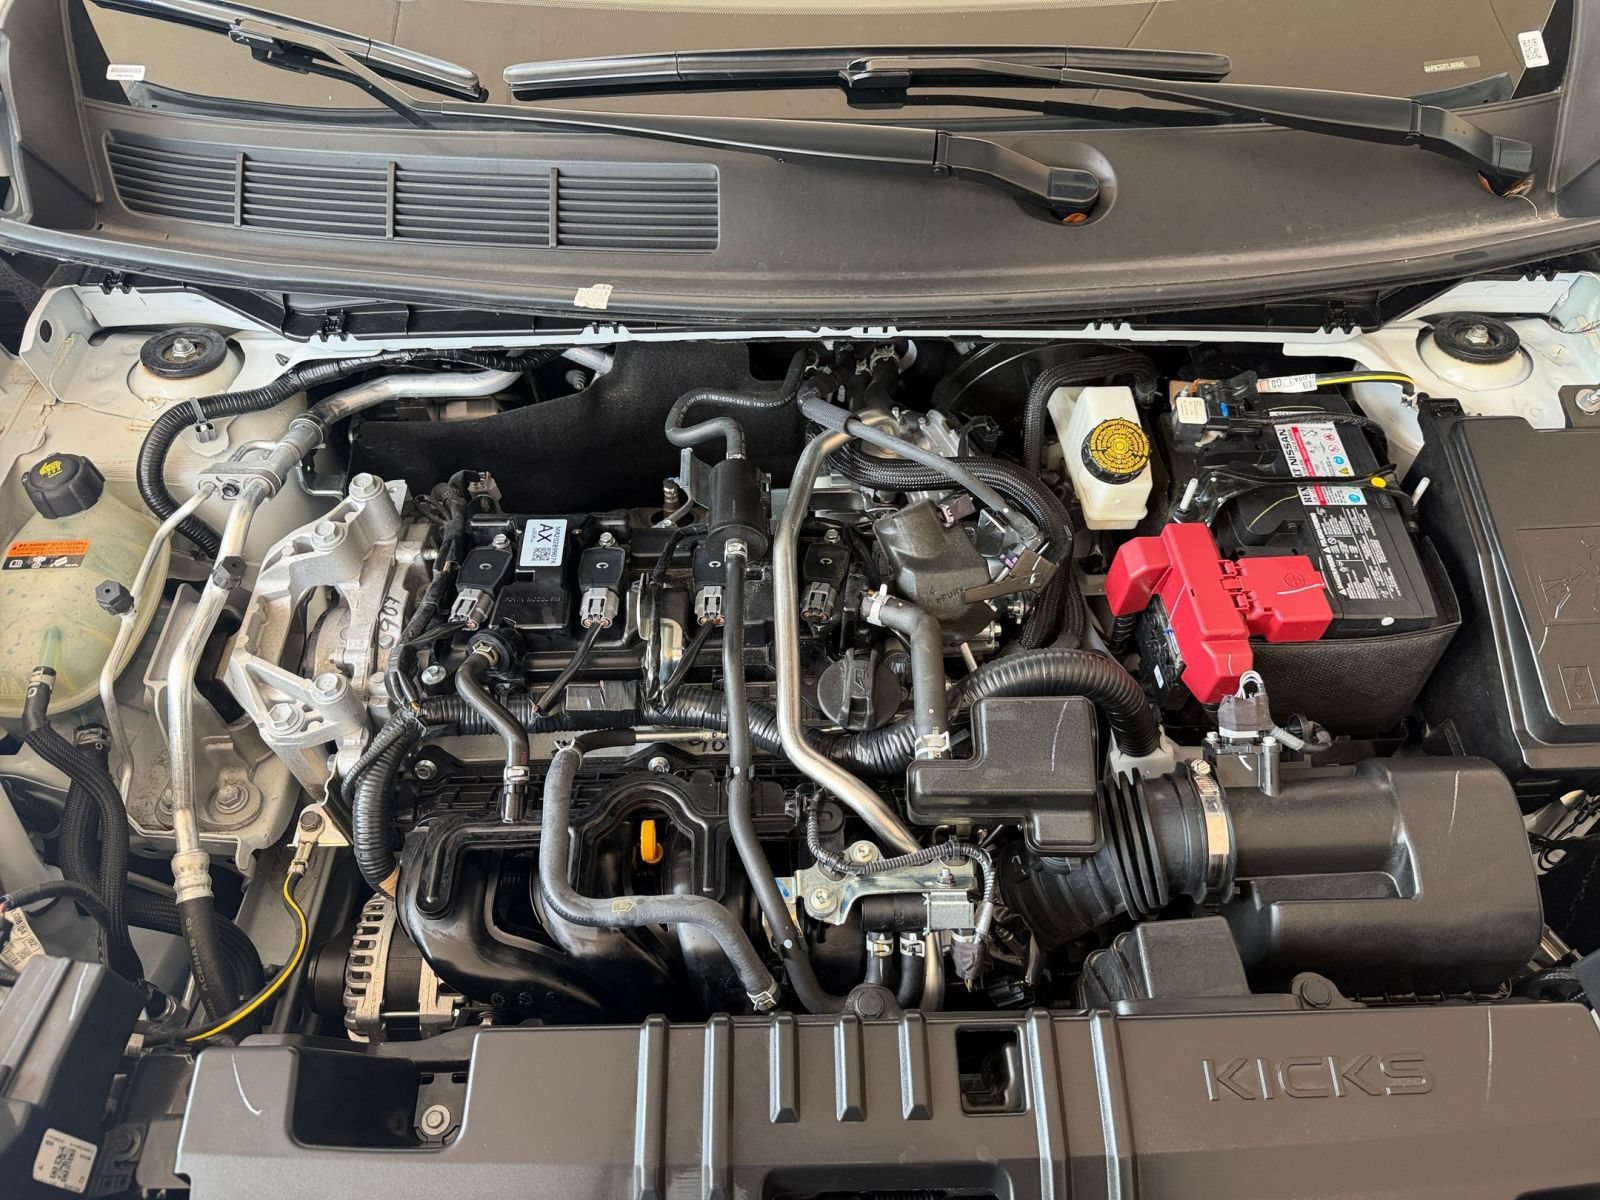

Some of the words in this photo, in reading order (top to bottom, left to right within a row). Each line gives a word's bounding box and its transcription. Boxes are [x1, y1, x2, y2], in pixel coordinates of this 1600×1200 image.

[1279, 428, 1299, 466] NISSAN
[536, 523, 554, 543] AX
[1202, 1053, 1433, 1101] KICKS
